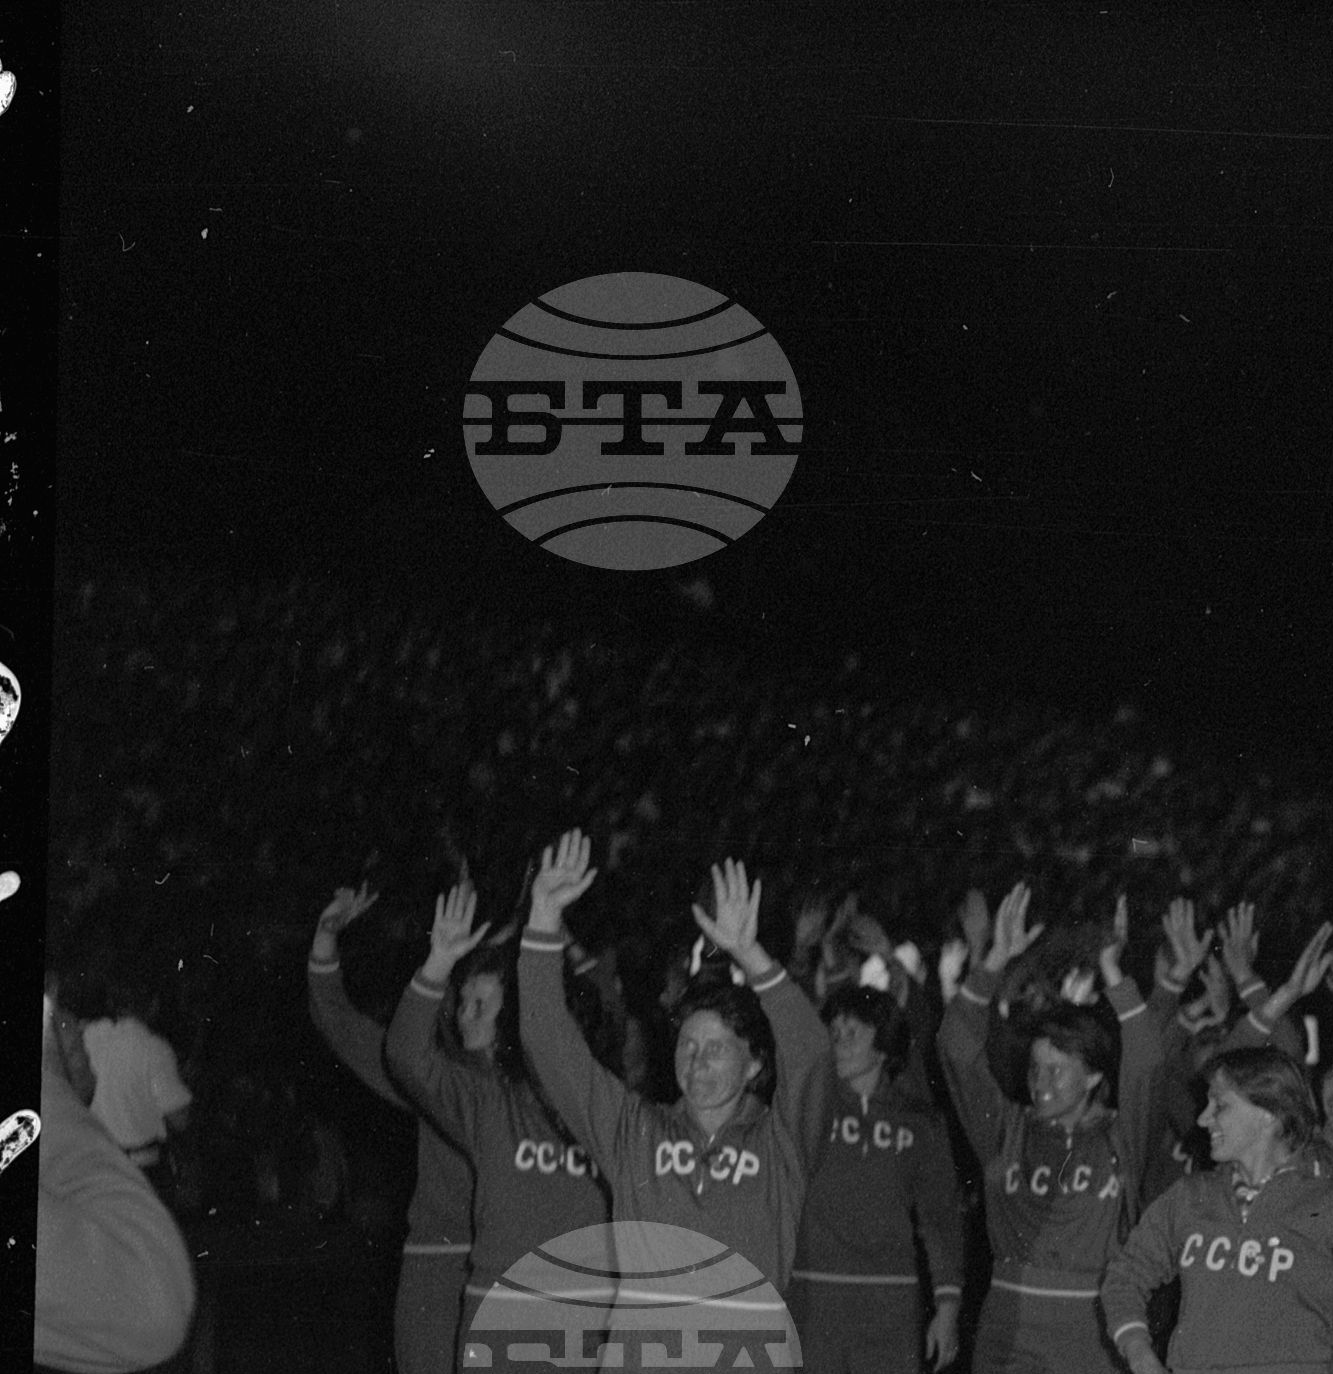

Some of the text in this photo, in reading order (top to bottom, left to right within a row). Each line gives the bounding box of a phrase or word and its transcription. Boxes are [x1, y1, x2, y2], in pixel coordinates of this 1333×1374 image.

[830, 1116, 914, 1153] ССР
[655, 1140, 759, 1185] СССР
[1179, 1233, 1294, 1282] СССР
